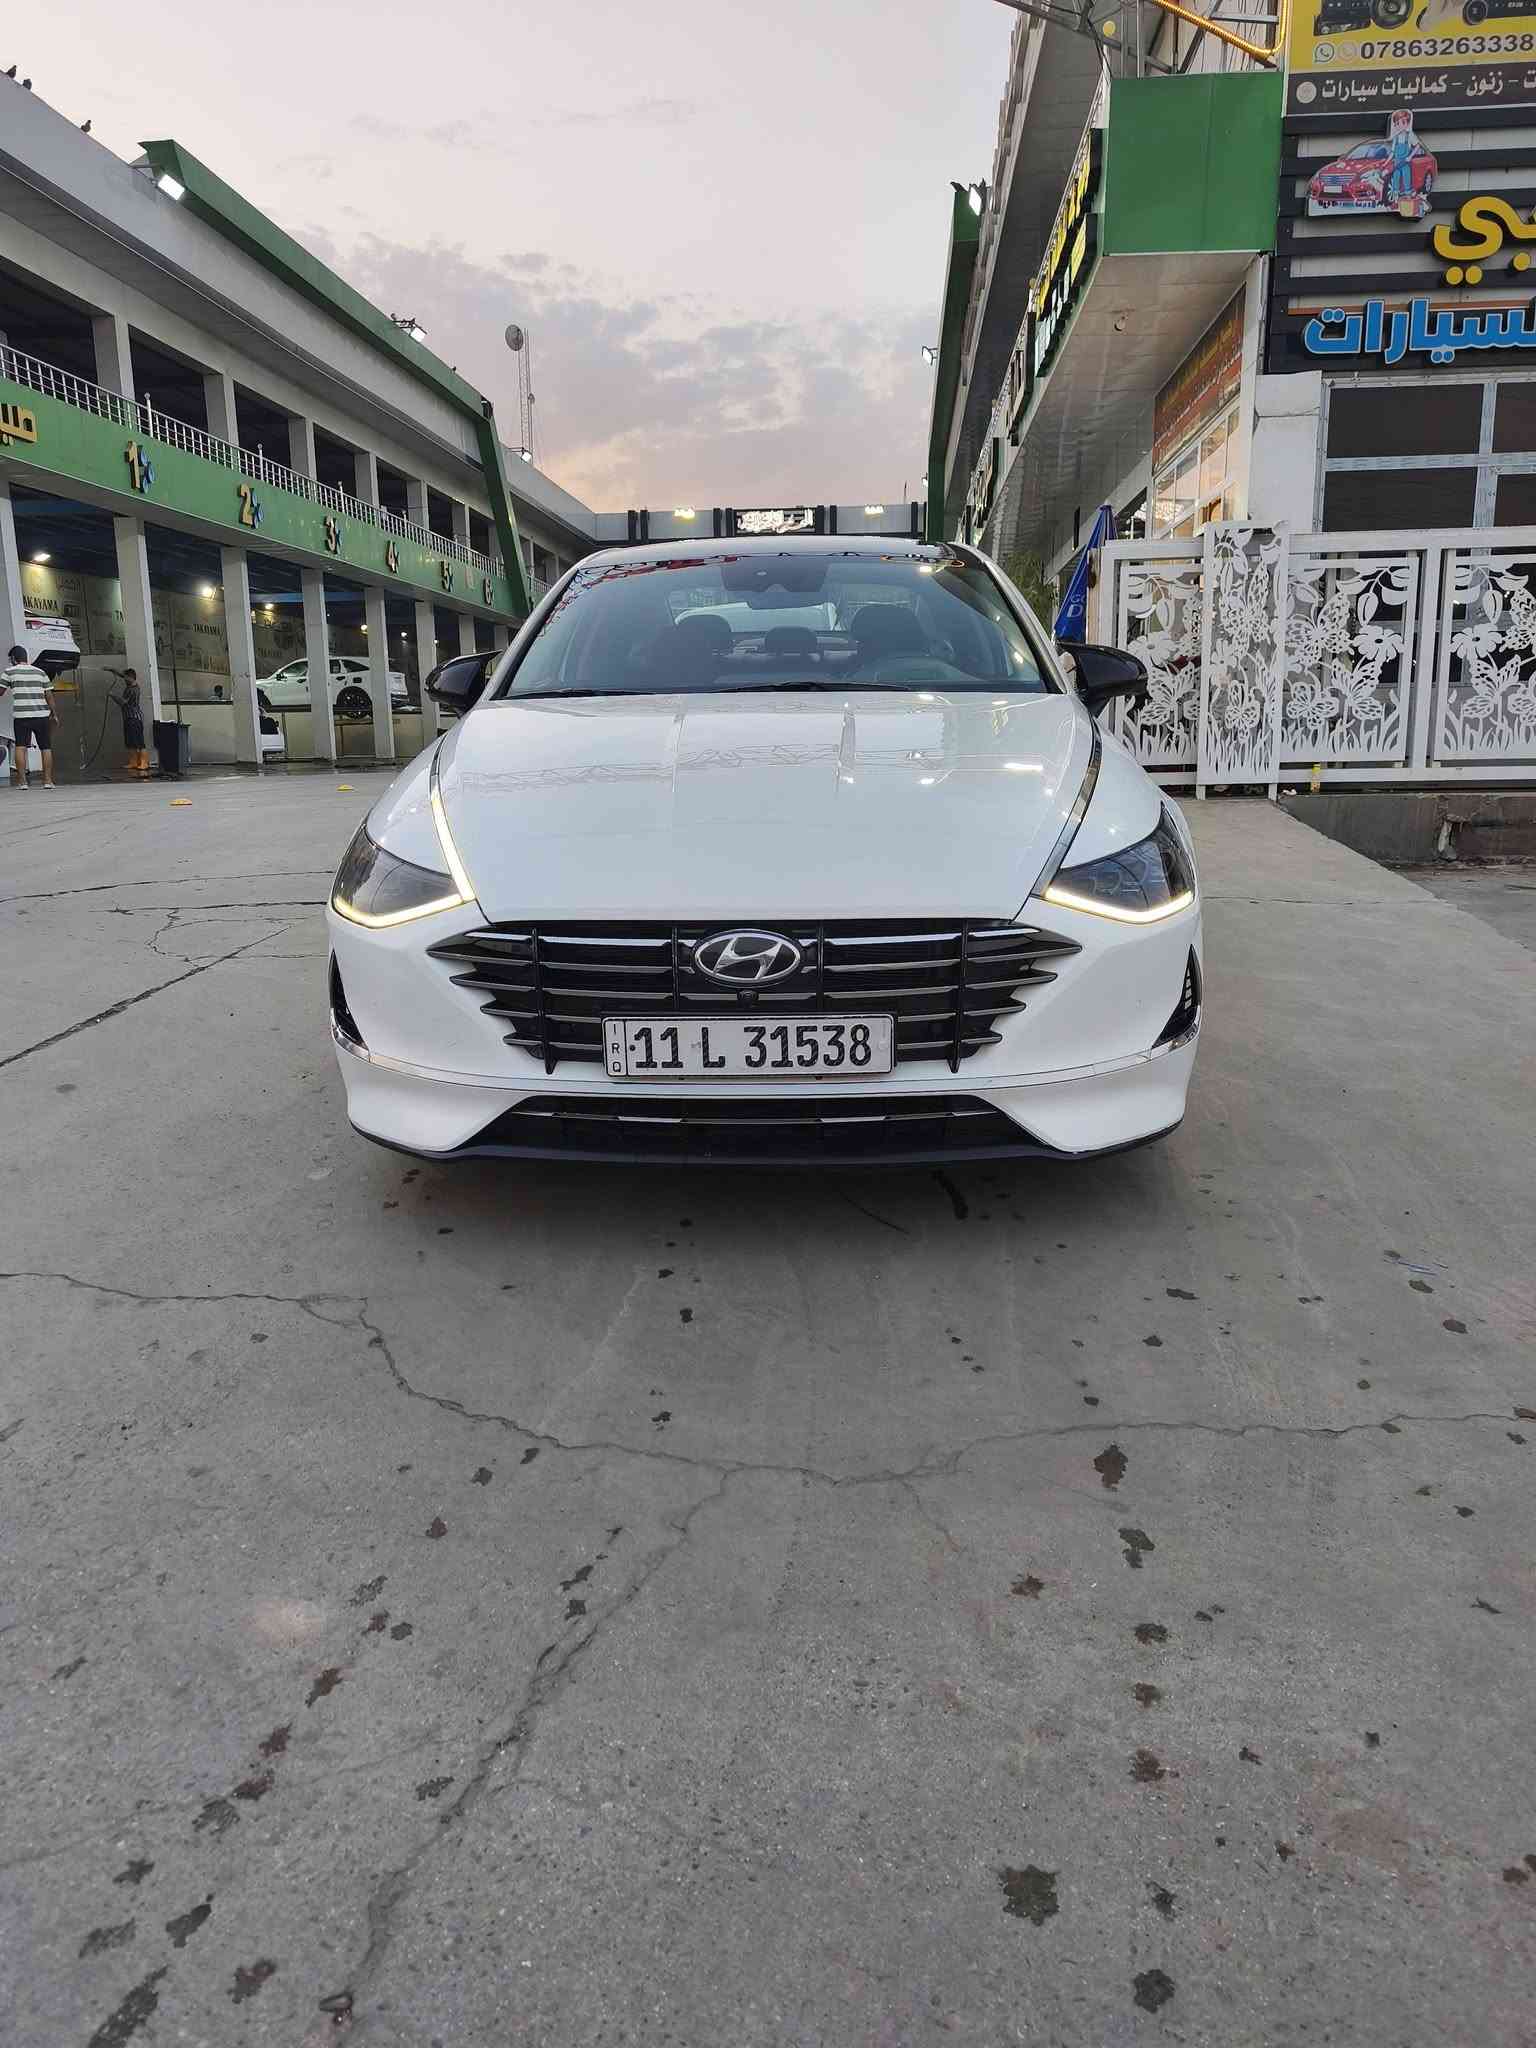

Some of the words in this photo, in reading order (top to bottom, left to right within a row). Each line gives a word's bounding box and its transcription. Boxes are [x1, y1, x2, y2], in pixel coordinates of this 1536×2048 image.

[1360, 33, 1534, 60] 07863263338
[1321, 79, 1378, 102] سيارات
[1381, 74, 1448, 100] كماليات
[633, 1026, 684, 1069] 11
[701, 1026, 726, 1069] L
[743, 1023, 872, 1068] 31538
